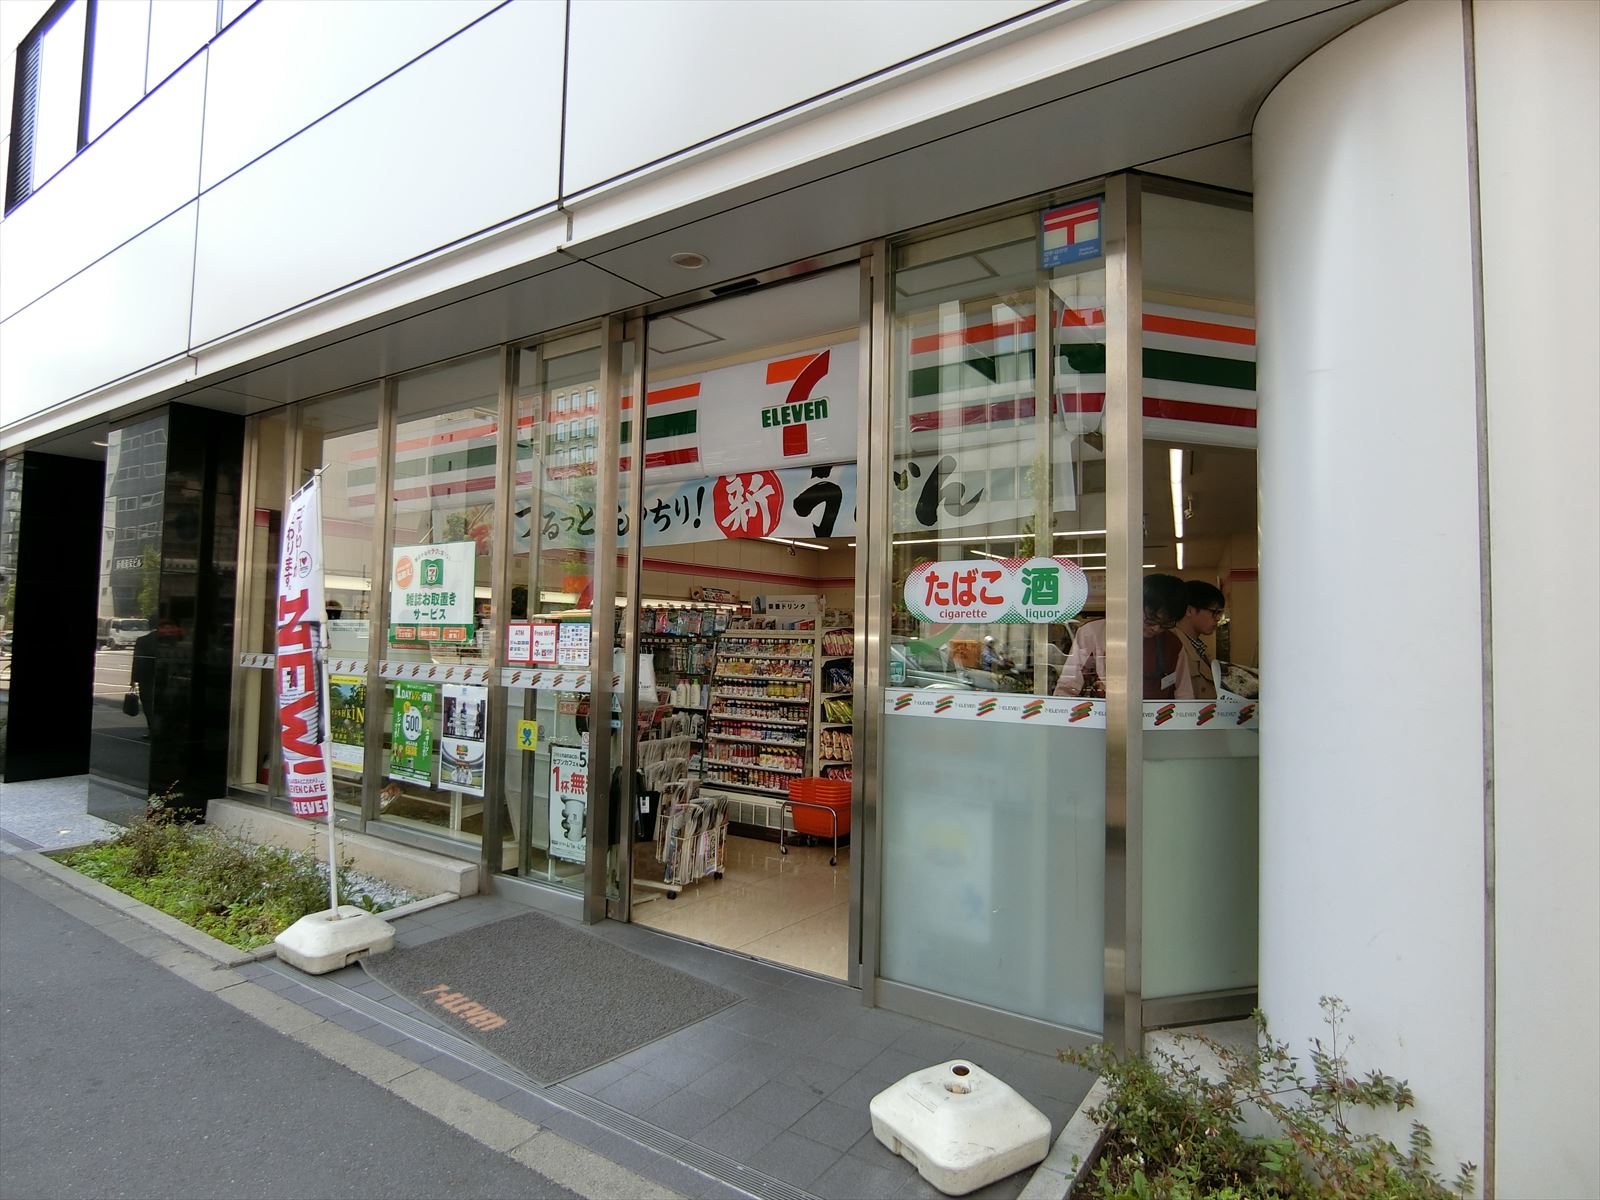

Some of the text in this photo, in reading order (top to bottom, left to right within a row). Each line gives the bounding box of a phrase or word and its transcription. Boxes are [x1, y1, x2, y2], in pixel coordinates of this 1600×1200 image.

[720, 474, 775, 533] 新
[925, 567, 1059, 607] たばこ 酒
[413, 608, 446, 620] サービス
[939, 608, 1060, 619] cigarette liquor
[405, 715, 420, 732] 500
[552, 766, 589, 795] 1杯無
